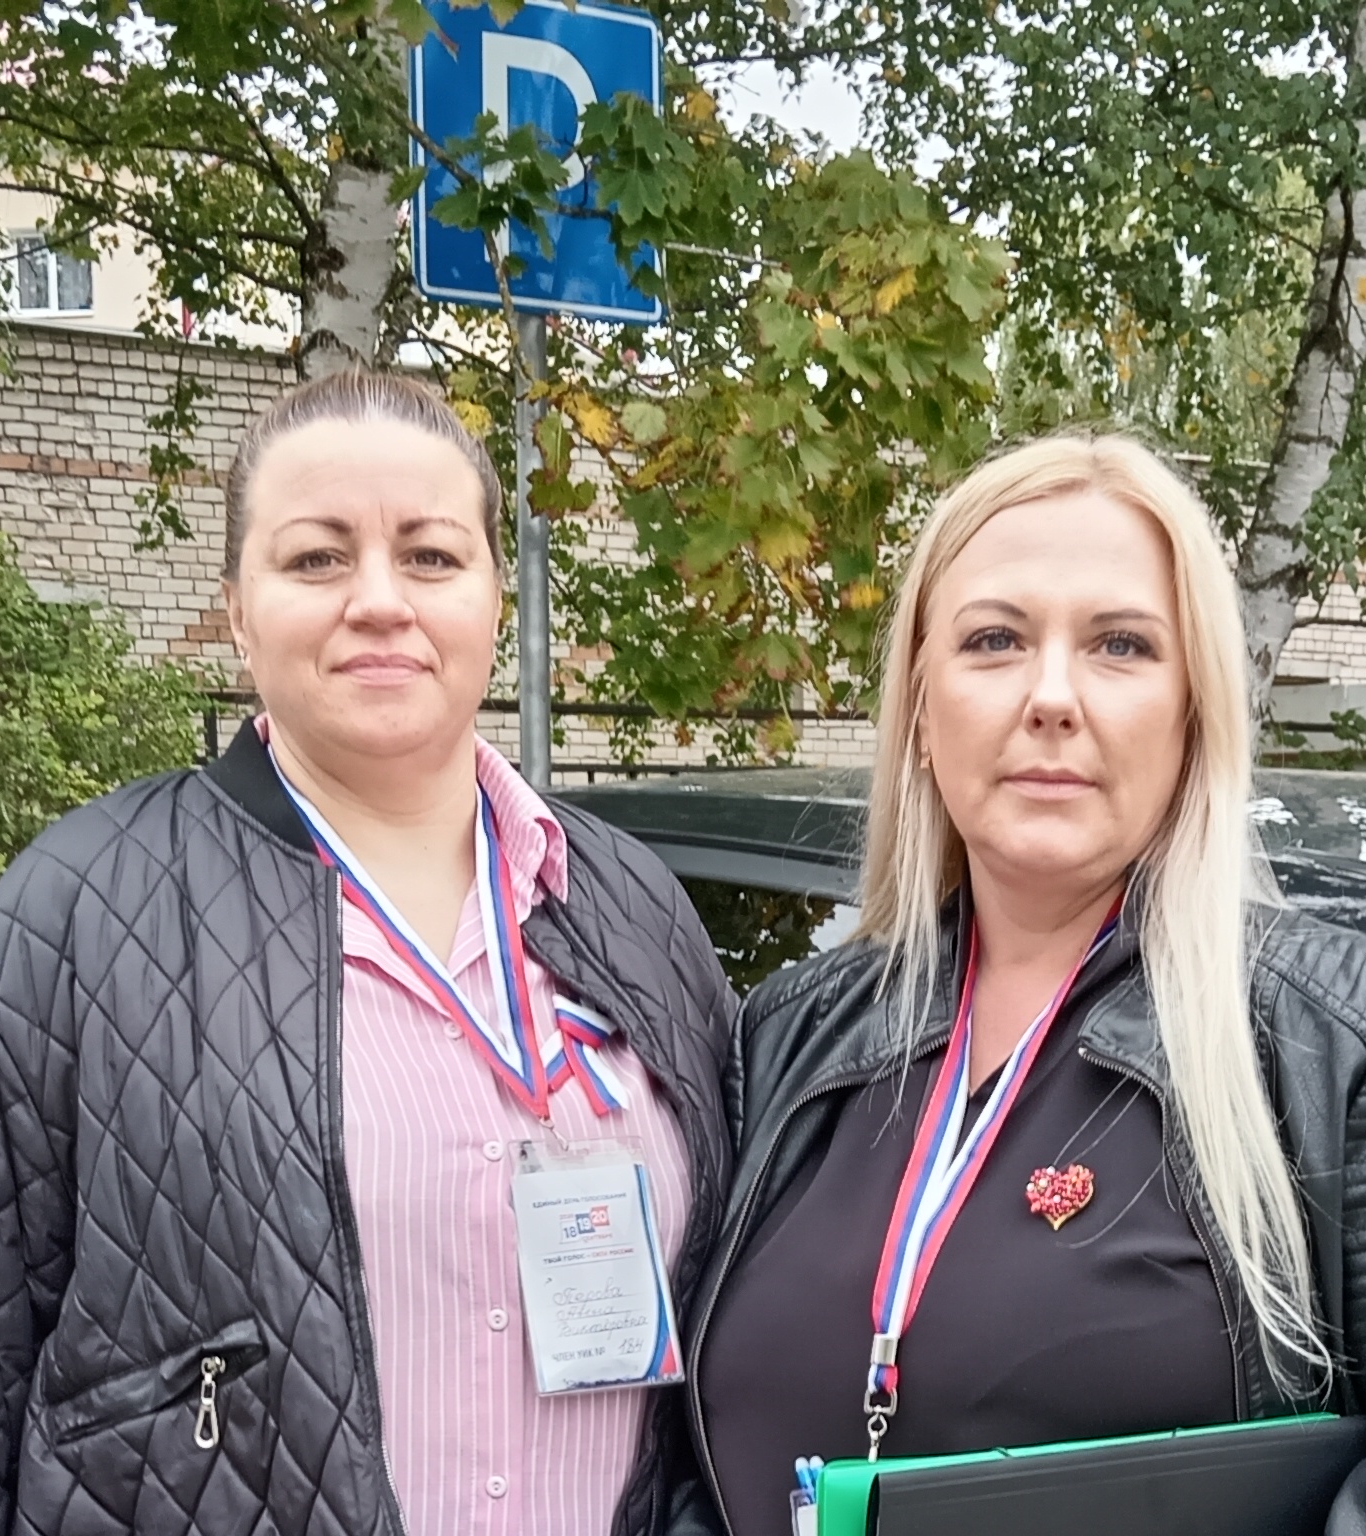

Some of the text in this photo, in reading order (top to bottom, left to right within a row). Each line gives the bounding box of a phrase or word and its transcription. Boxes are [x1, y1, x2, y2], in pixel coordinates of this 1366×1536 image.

[482, 31, 599, 263] P
[563, 1226, 577, 1239] 18
[577, 1217, 591, 1231] 19
[591, 1209, 607, 1224] 20
